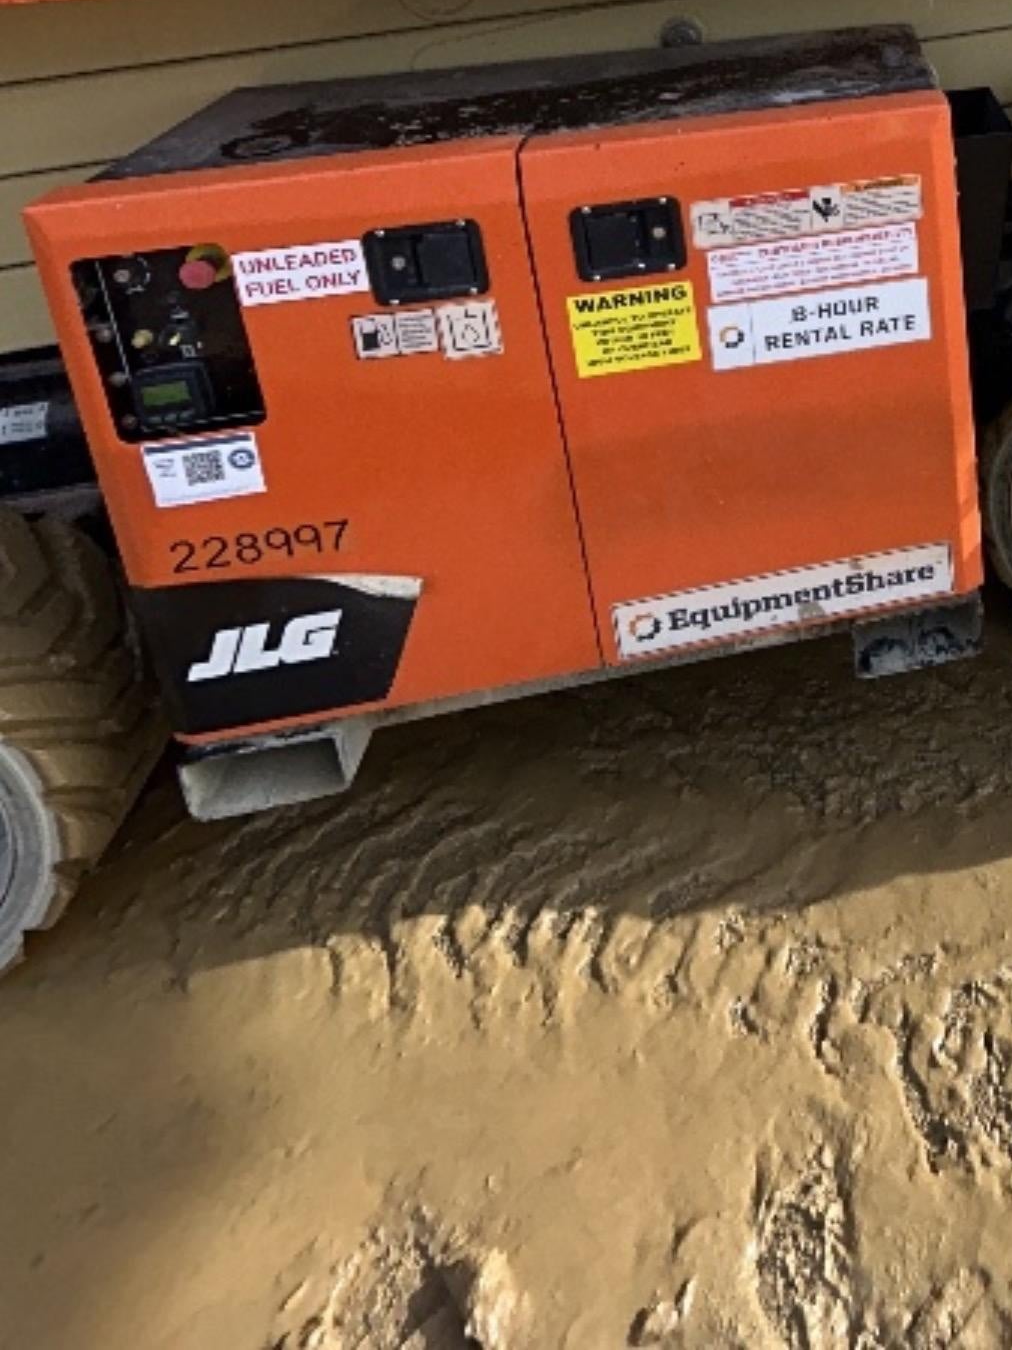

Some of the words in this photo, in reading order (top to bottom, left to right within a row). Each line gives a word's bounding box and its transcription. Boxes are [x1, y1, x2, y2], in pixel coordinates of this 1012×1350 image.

[239, 248, 358, 275] UNLEADED
[245, 277, 301, 298] FUEL
[305, 270, 361, 291] ONLY
[573, 284, 688, 313] WARNING
[791, 295, 881, 324] 8-HOUR
[765, 323, 852, 353] RENTAL
[859, 314, 917, 340] RATE
[169, 518, 350, 574] 228997
[668, 564, 936, 632] EquipmentShare
[187, 609, 342, 683] JLG
